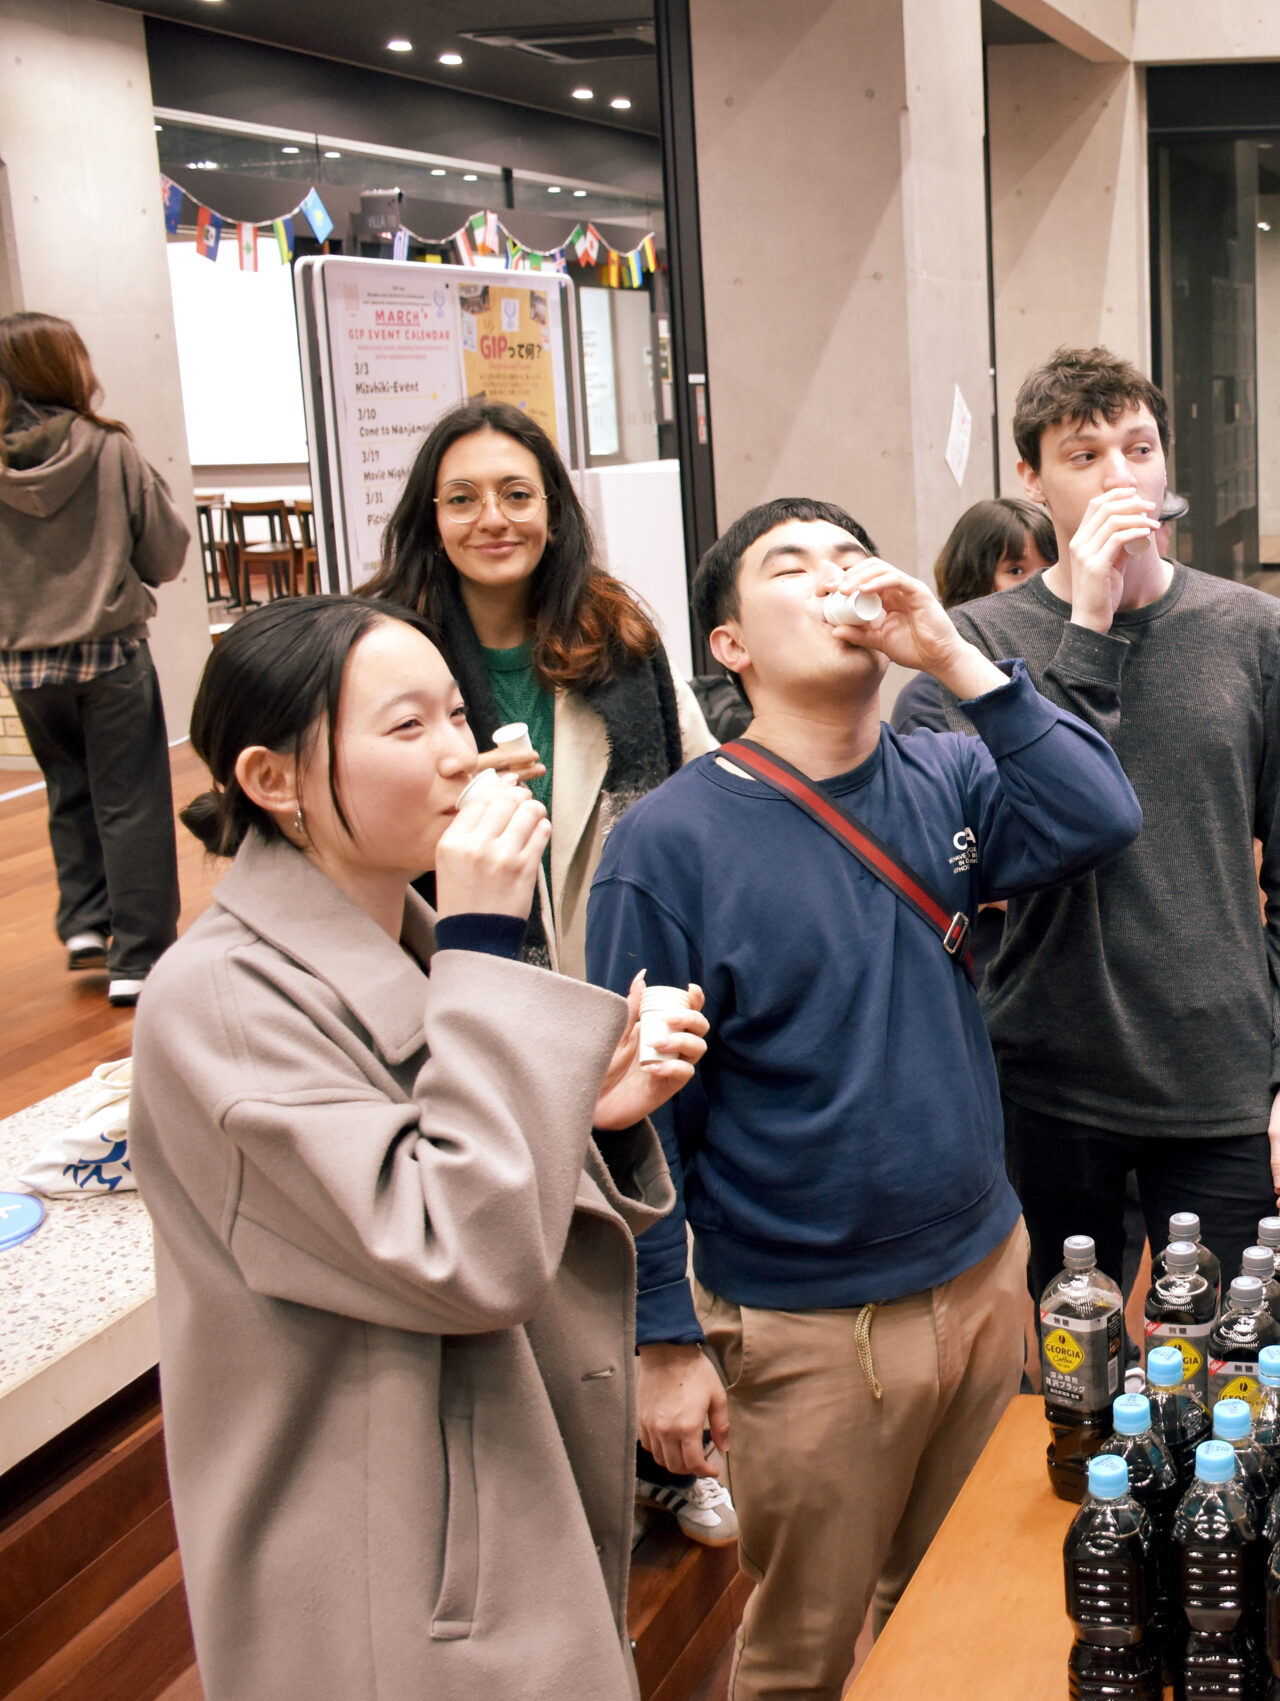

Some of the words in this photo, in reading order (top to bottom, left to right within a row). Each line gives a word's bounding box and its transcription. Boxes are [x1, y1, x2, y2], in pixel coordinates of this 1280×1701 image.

[375, 310, 420, 324] MARCH
[348, 328, 365, 341] GIP
[368, 329, 400, 341] EVENT
[405, 330, 451, 341] CALENDAR
[354, 362, 369, 376] 3/3
[355, 381, 419, 394] Mizuhiki-Event
[358, 408, 376, 421] 3/10
[360, 426, 379, 437] Come
[381, 425, 390, 435] to
[362, 450, 380, 463] 3/17
[363, 470, 386, 481] Movie
[366, 491, 383, 505] 3/31
[1045, 1343, 1081, 1359] GEORGIA
